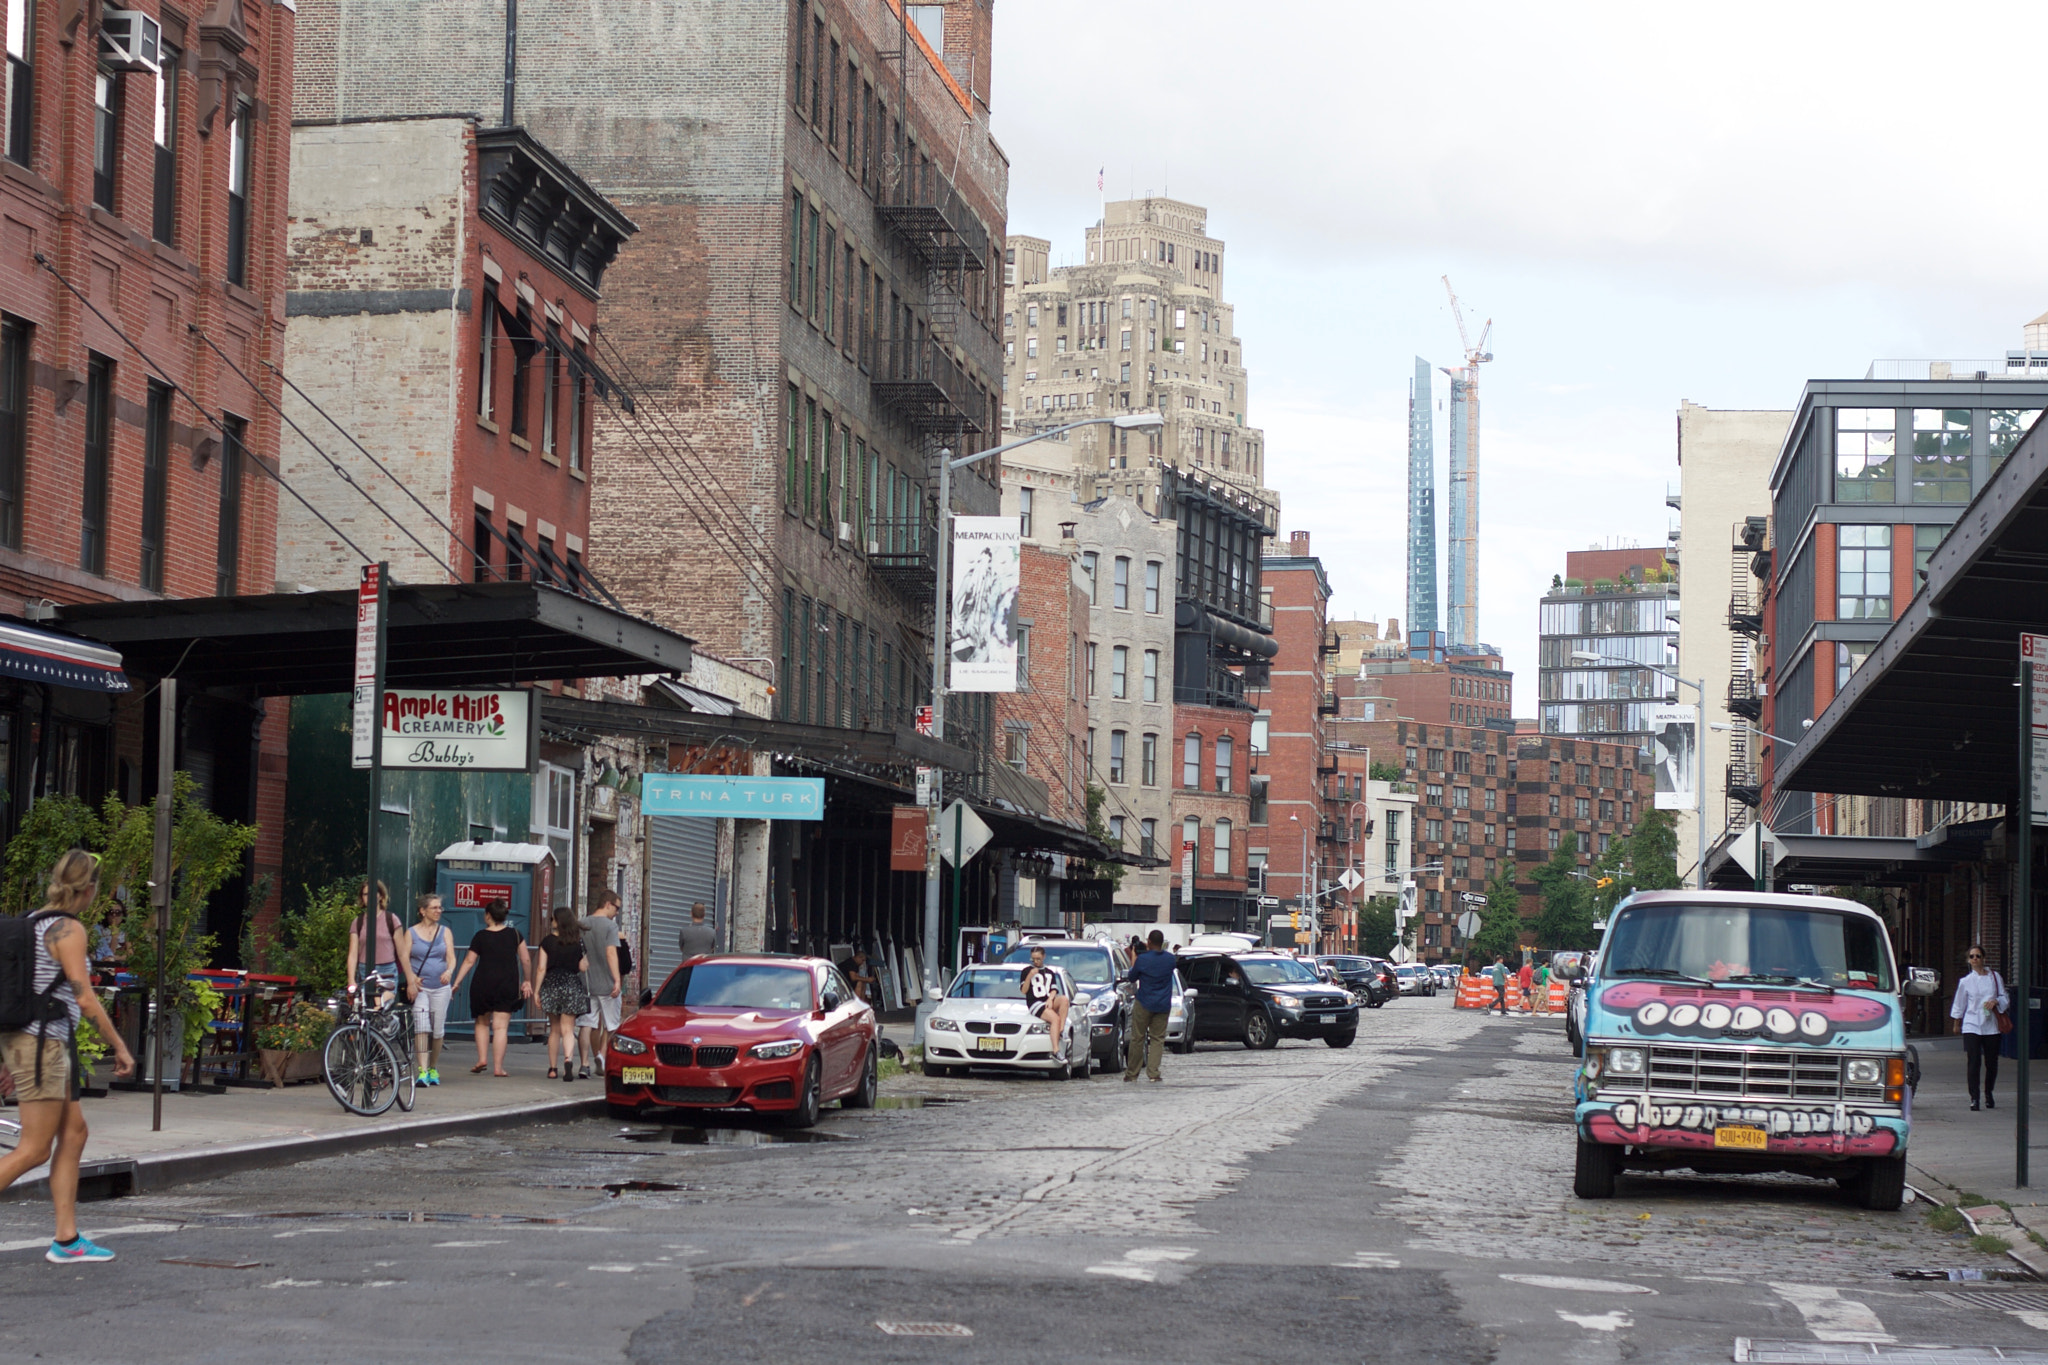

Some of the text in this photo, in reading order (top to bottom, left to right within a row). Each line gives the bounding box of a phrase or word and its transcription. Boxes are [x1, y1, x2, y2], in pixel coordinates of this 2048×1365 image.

[955, 531, 1020, 541] MEATPACKING
[359, 605, 366, 621] 3
[2024, 636, 2031, 654] 3
[383, 692, 447, 734] Ample
[452, 693, 499, 722] Hills
[402, 720, 486, 736] CREAMERY
[408, 740, 475, 766] Bubby's
[918, 775, 924, 784] 2
[651, 788, 813, 804] TRINA TURK
[995, 944, 1003, 955] P
[1030, 973, 1052, 998] 81
[1720, 1029, 1772, 1038] DODGE
